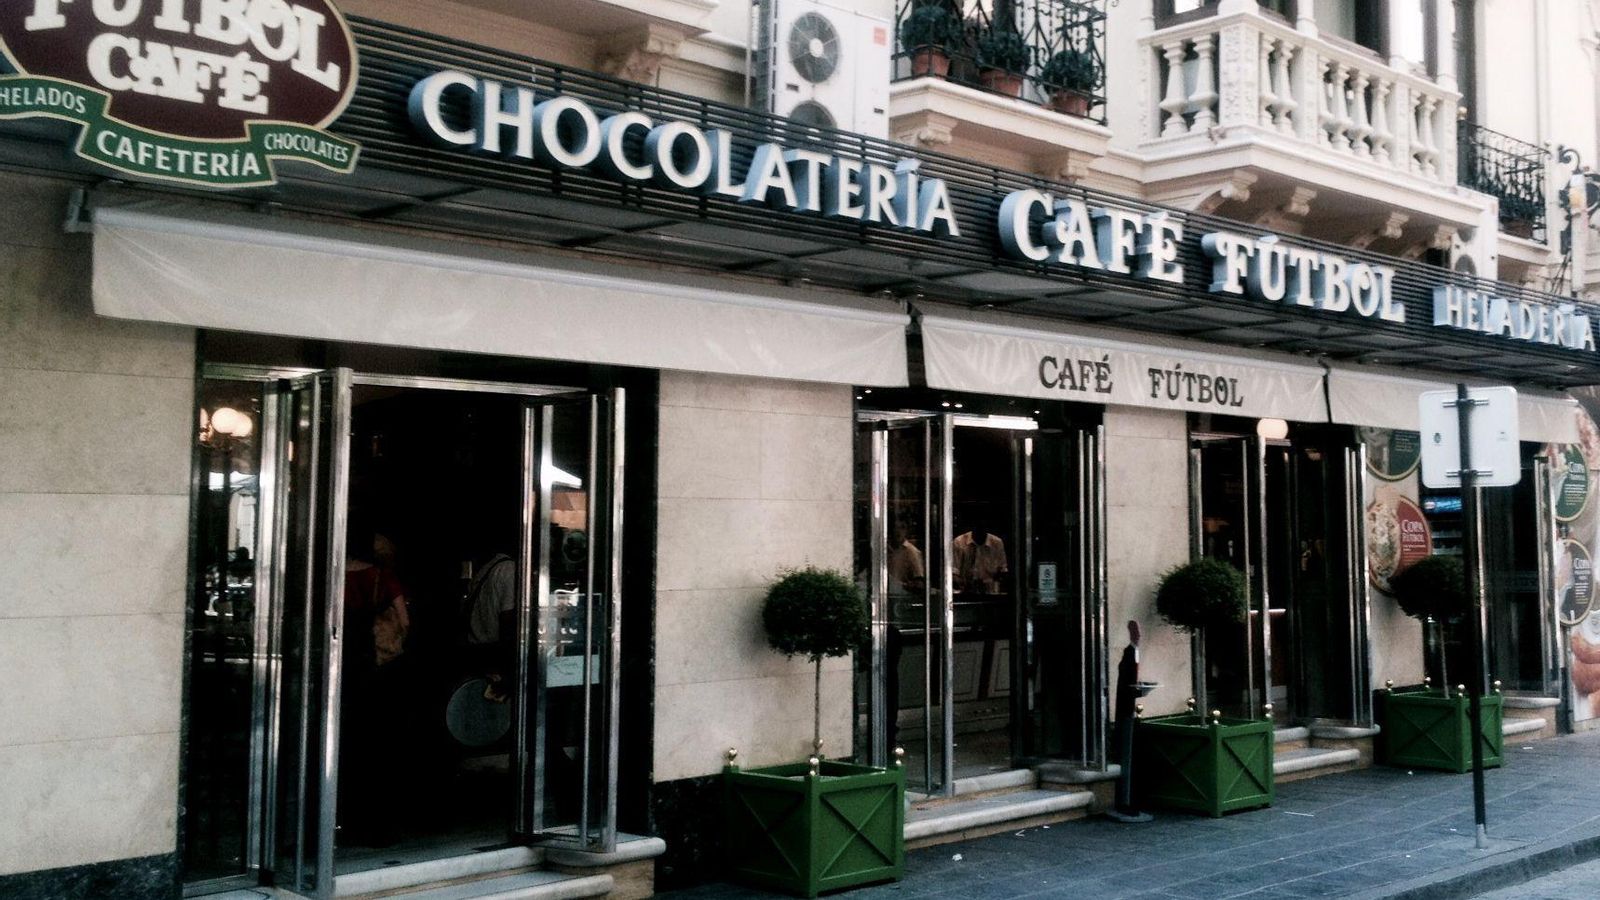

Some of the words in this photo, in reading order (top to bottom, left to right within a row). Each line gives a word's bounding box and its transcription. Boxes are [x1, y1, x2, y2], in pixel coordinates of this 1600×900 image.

[0, 87, 86, 114] HELADOS
[97, 130, 261, 177] CAFETERÍA
[264, 132, 349, 163] CHOCOLATES
[409, 70, 961, 238] CHOCOLATERÍA
[1000, 188, 1184, 284] CAFÉ
[1203, 232, 1406, 323] FÚTBOL
[1433, 284, 1597, 352] HELADERÍA
[1039, 354, 1114, 394] CAFÉ
[1147, 363, 1244, 407] FÚTBOL
